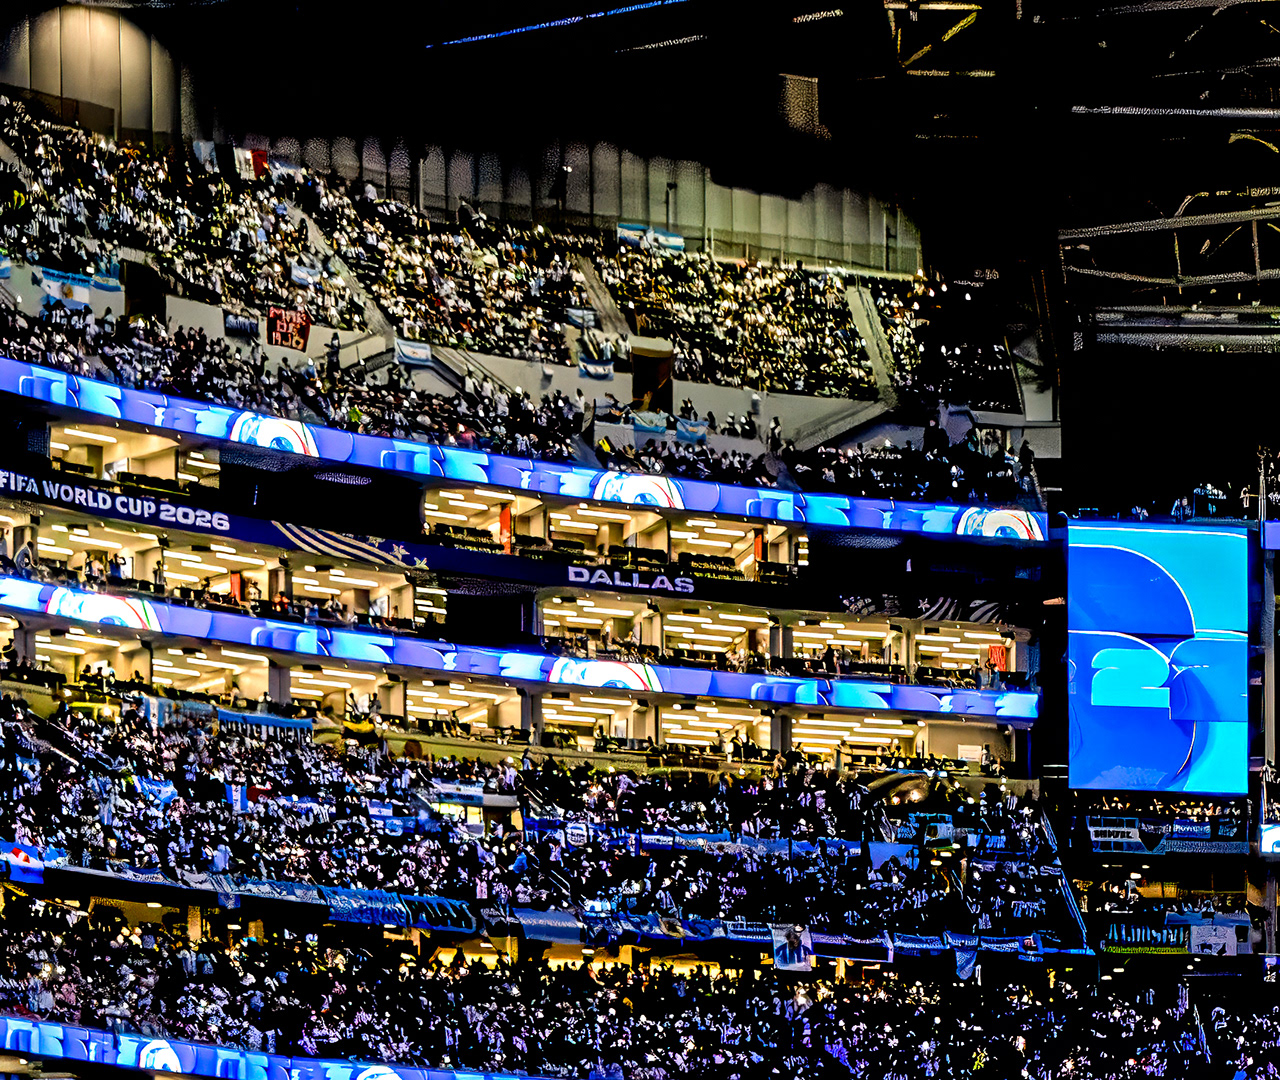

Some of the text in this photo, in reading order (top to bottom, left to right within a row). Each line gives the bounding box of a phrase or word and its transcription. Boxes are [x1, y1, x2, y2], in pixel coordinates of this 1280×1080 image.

[0, 469, 231, 531] FIFA WORLD CUP 2026
[568, 565, 695, 594] DALLAS
